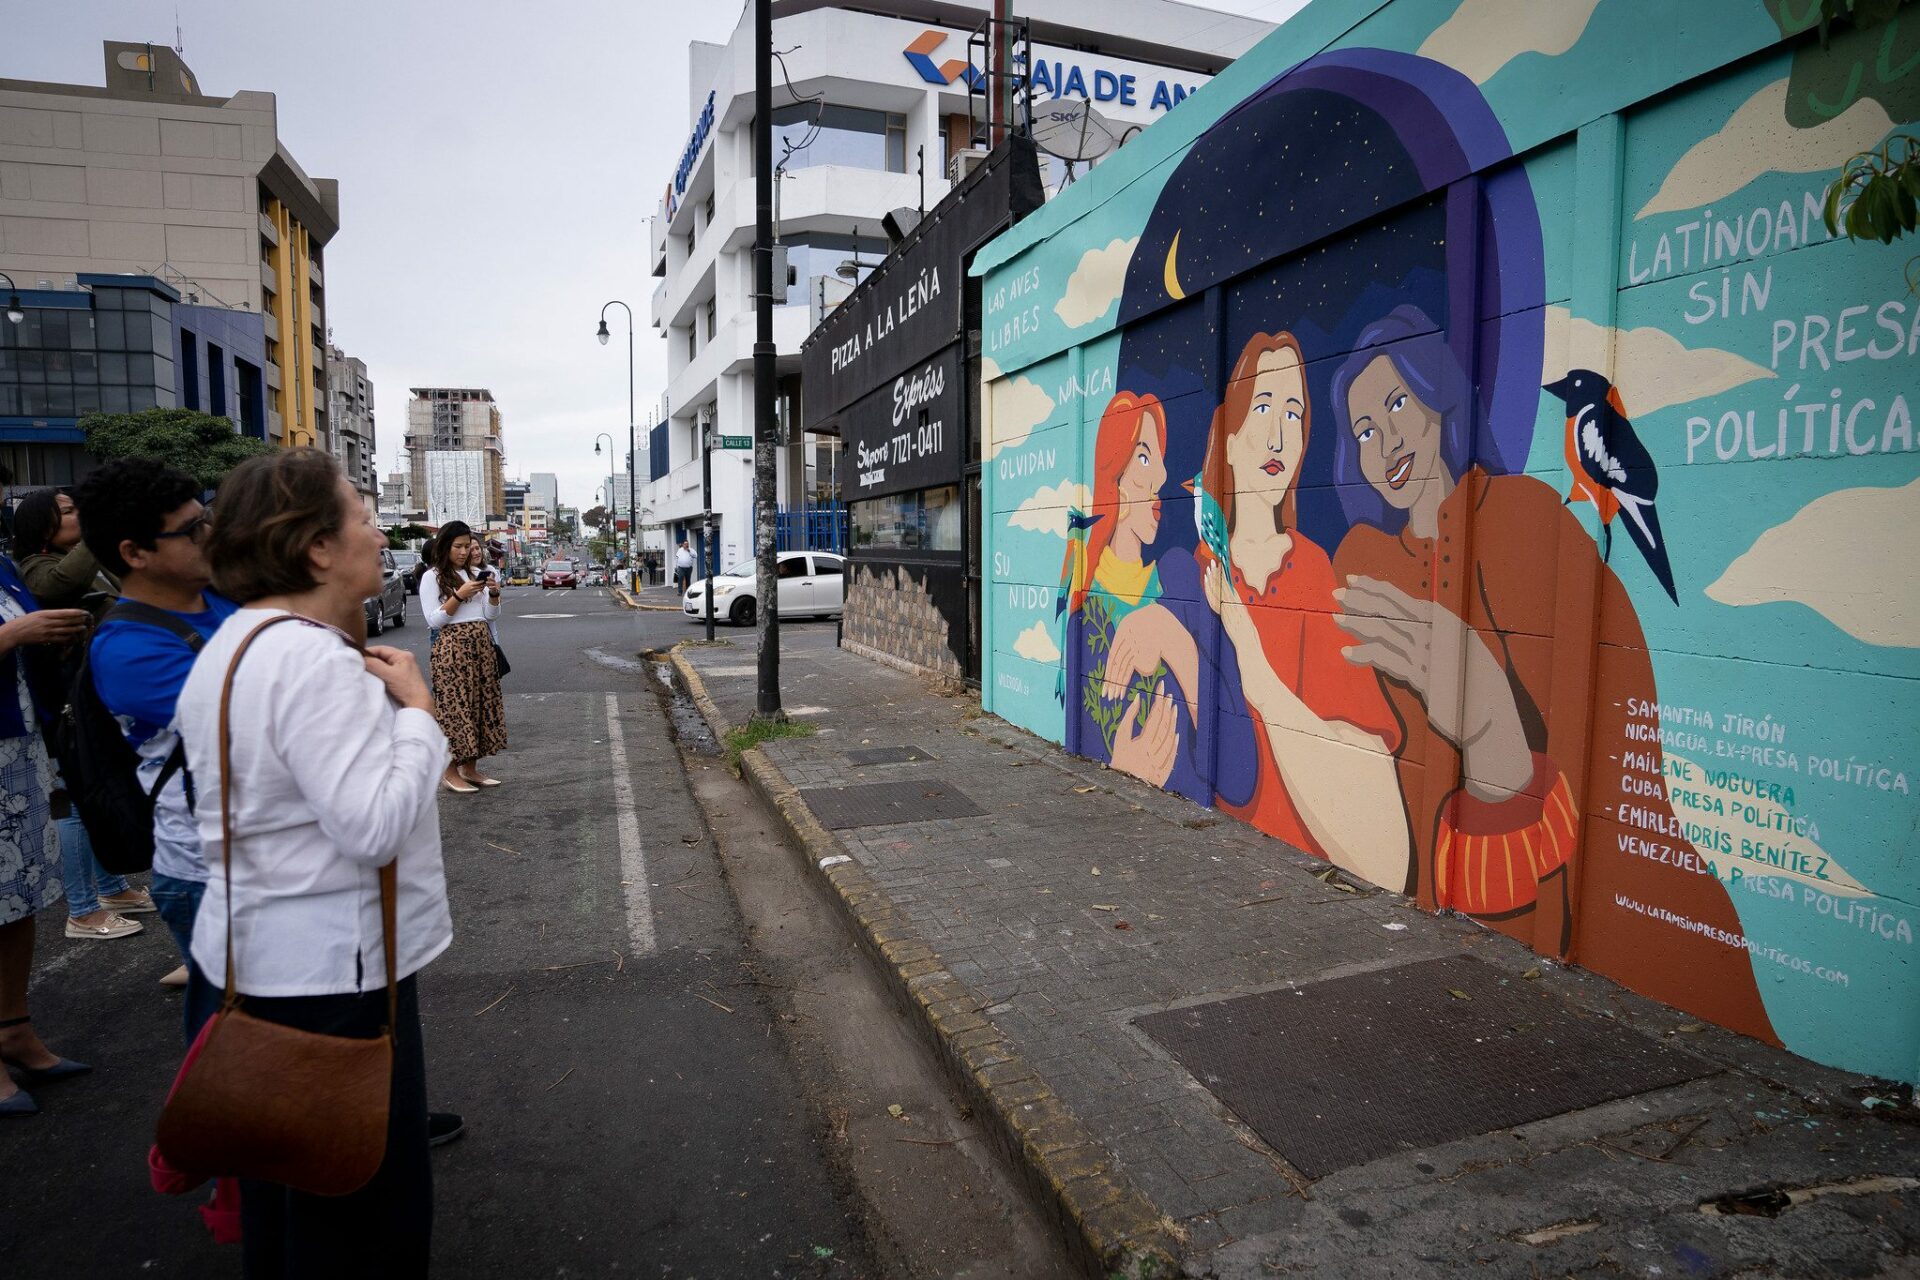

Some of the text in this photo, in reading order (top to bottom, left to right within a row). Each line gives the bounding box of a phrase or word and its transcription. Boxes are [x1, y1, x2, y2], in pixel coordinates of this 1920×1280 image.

[1095, 69, 1136, 107] DE
[1051, 112, 1080, 121] SKY
[1629, 181, 1865, 284] LATINOAM
[988, 266, 1040, 315] LAS AVES
[1684, 266, 1772, 324] SIN
[832, 265, 940, 375] PIZZA A LA LEÑA
[991, 305, 1040, 351] LIBRES
[1059, 366, 1112, 405] NUNCA
[892, 421, 942, 465] 7121-0411
[1686, 383, 1920, 464] POLÍTICA
[1001, 448, 1056, 480] OLVIDAN
[995, 552, 1010, 576] SU
[1009, 587, 1049, 610] NIDO
[1627, 698, 1713, 730] SAMANTHA
[1722, 713, 1785, 744] JIRÓN
[1623, 752, 1692, 781] MAILENE
[1705, 769, 1795, 806] NOGUERA
[1808, 756, 1909, 795] POLÍTICA
[1672, 788, 1724, 816] PRESA
[1731, 801, 1820, 840] POLÍTICA
[1741, 838, 1829, 880] BENÍTEZ
[1731, 867, 1794, 901] PRESA
[1804, 887, 1912, 944] POLÍTICA
